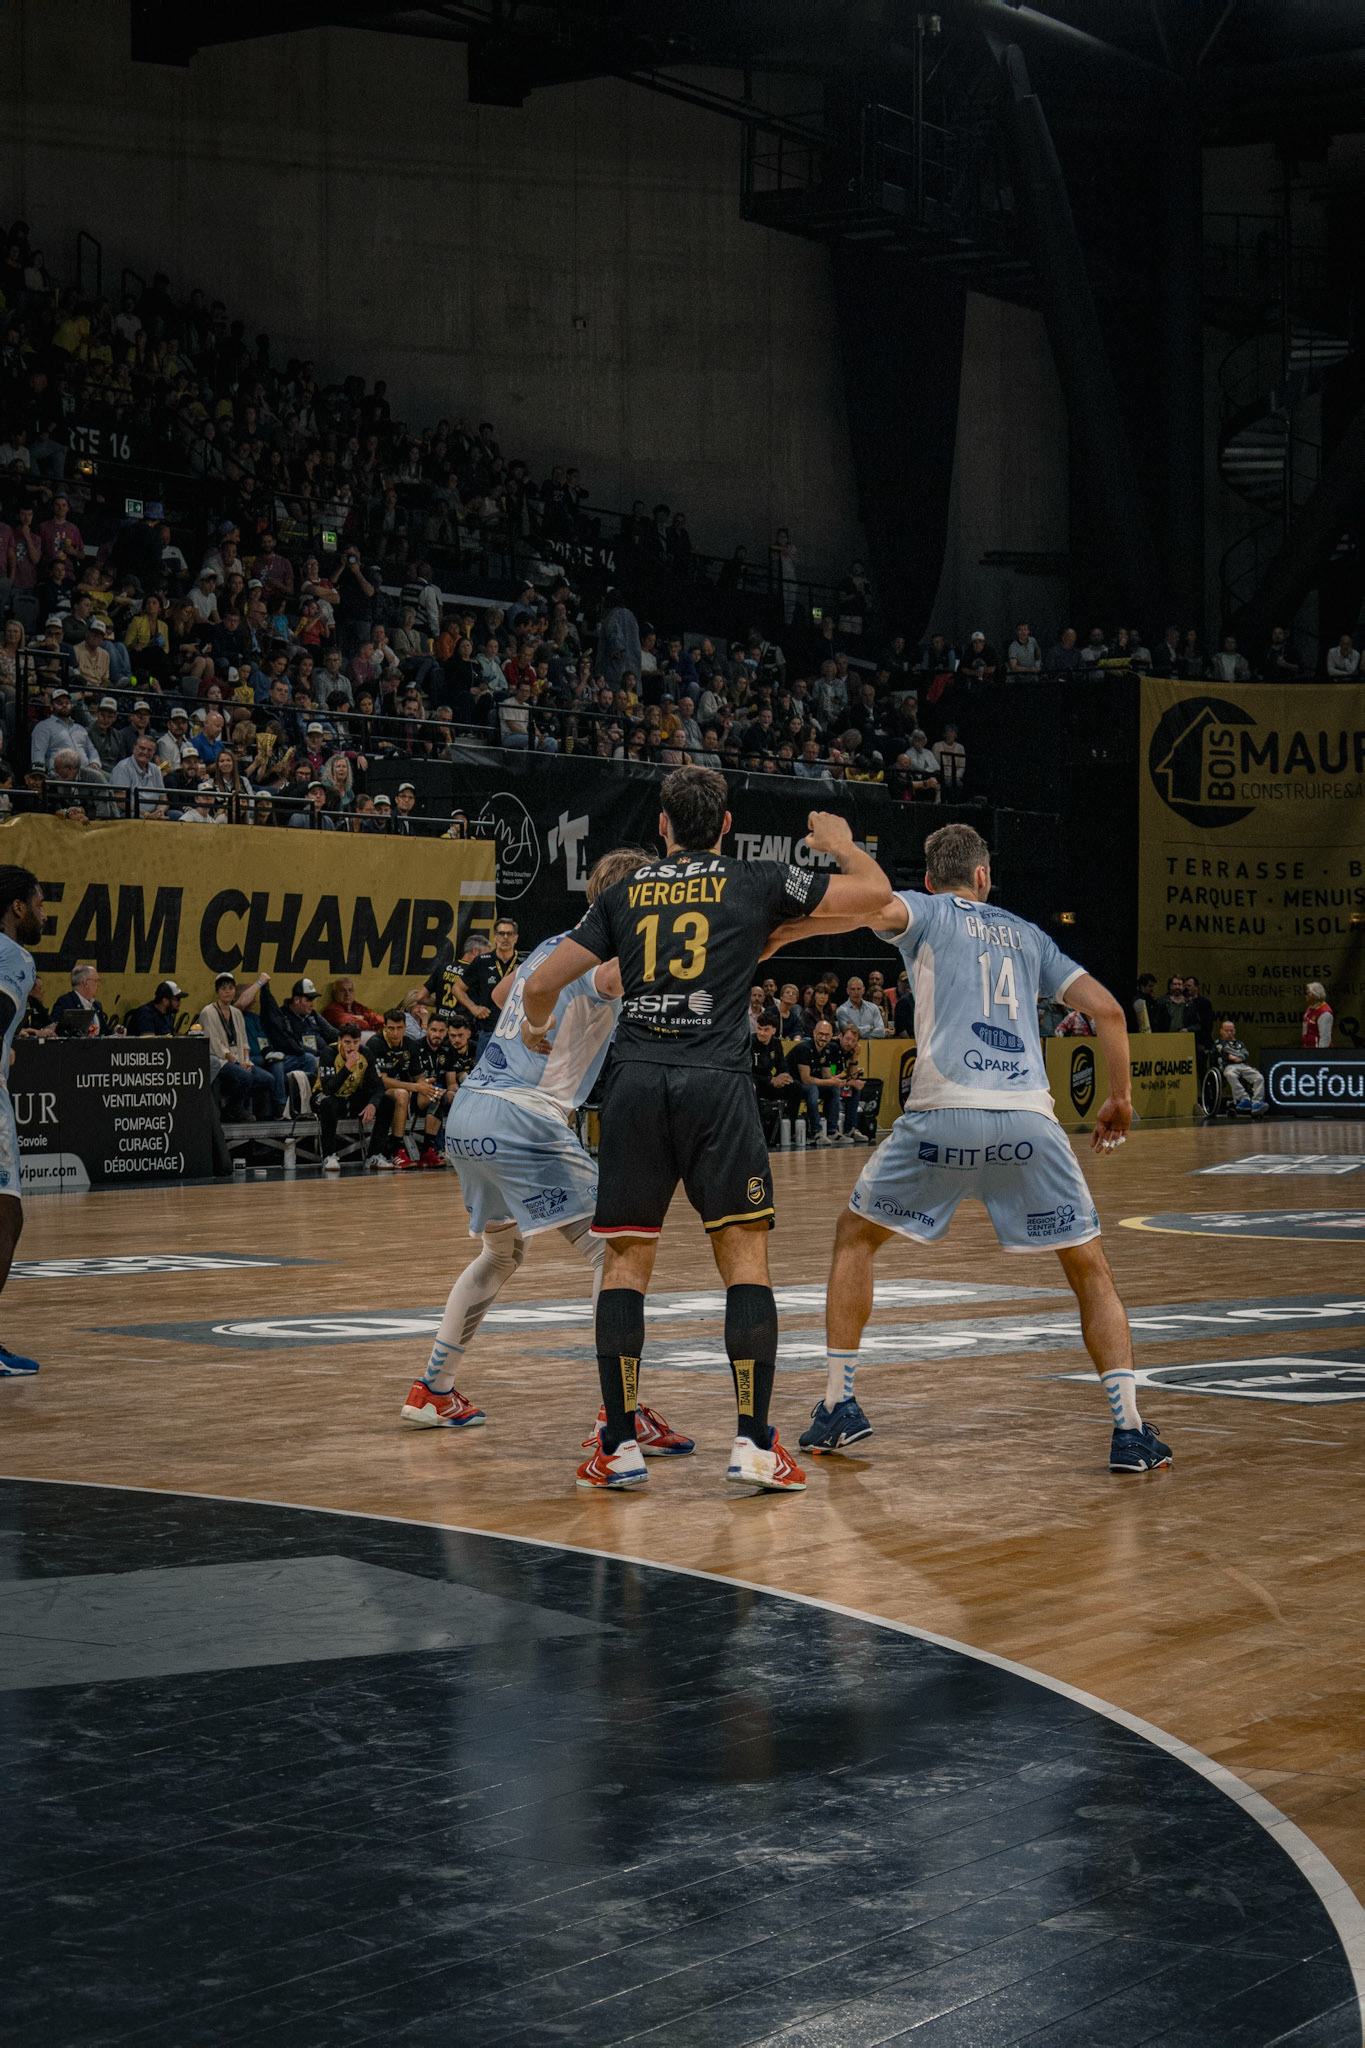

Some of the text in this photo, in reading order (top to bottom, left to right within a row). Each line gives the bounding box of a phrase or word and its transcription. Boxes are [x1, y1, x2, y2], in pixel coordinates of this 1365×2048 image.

[109, 433, 131, 460] 16
[600, 548, 616, 573] 14
[1207, 730, 1235, 800] BOIS
[735, 833, 792, 864] TEAM
[1166, 857, 1305, 879] TERRASSE
[628, 876, 728, 909] VERGELY
[1166, 886, 1257, 908] PARQUET
[33, 881, 183, 973] EAM
[1166, 914, 1266, 934] PANNEAU
[635, 911, 710, 983] 13
[1248, 965, 1332, 978] 9 AGENCES
[977, 951, 1020, 1021] 14
[670, 1017, 712, 1025] SERVICES
[76, 1074, 110, 1088] LUTTE
[112, 1073, 165, 1087] PUNAISES
[166, 1072, 181, 1086] DE
[12, 1092, 60, 1125] UR
[18, 1134, 48, 1147] Savoie
[20, 1165, 77, 1181] vipur.com
[874, 1201, 936, 1227] AQUALTER
[1027, 1223, 1056, 1231] CENTRE
[1053, 1225, 1073, 1235] LOIRE
[739, 1389, 751, 1406] TEAM
